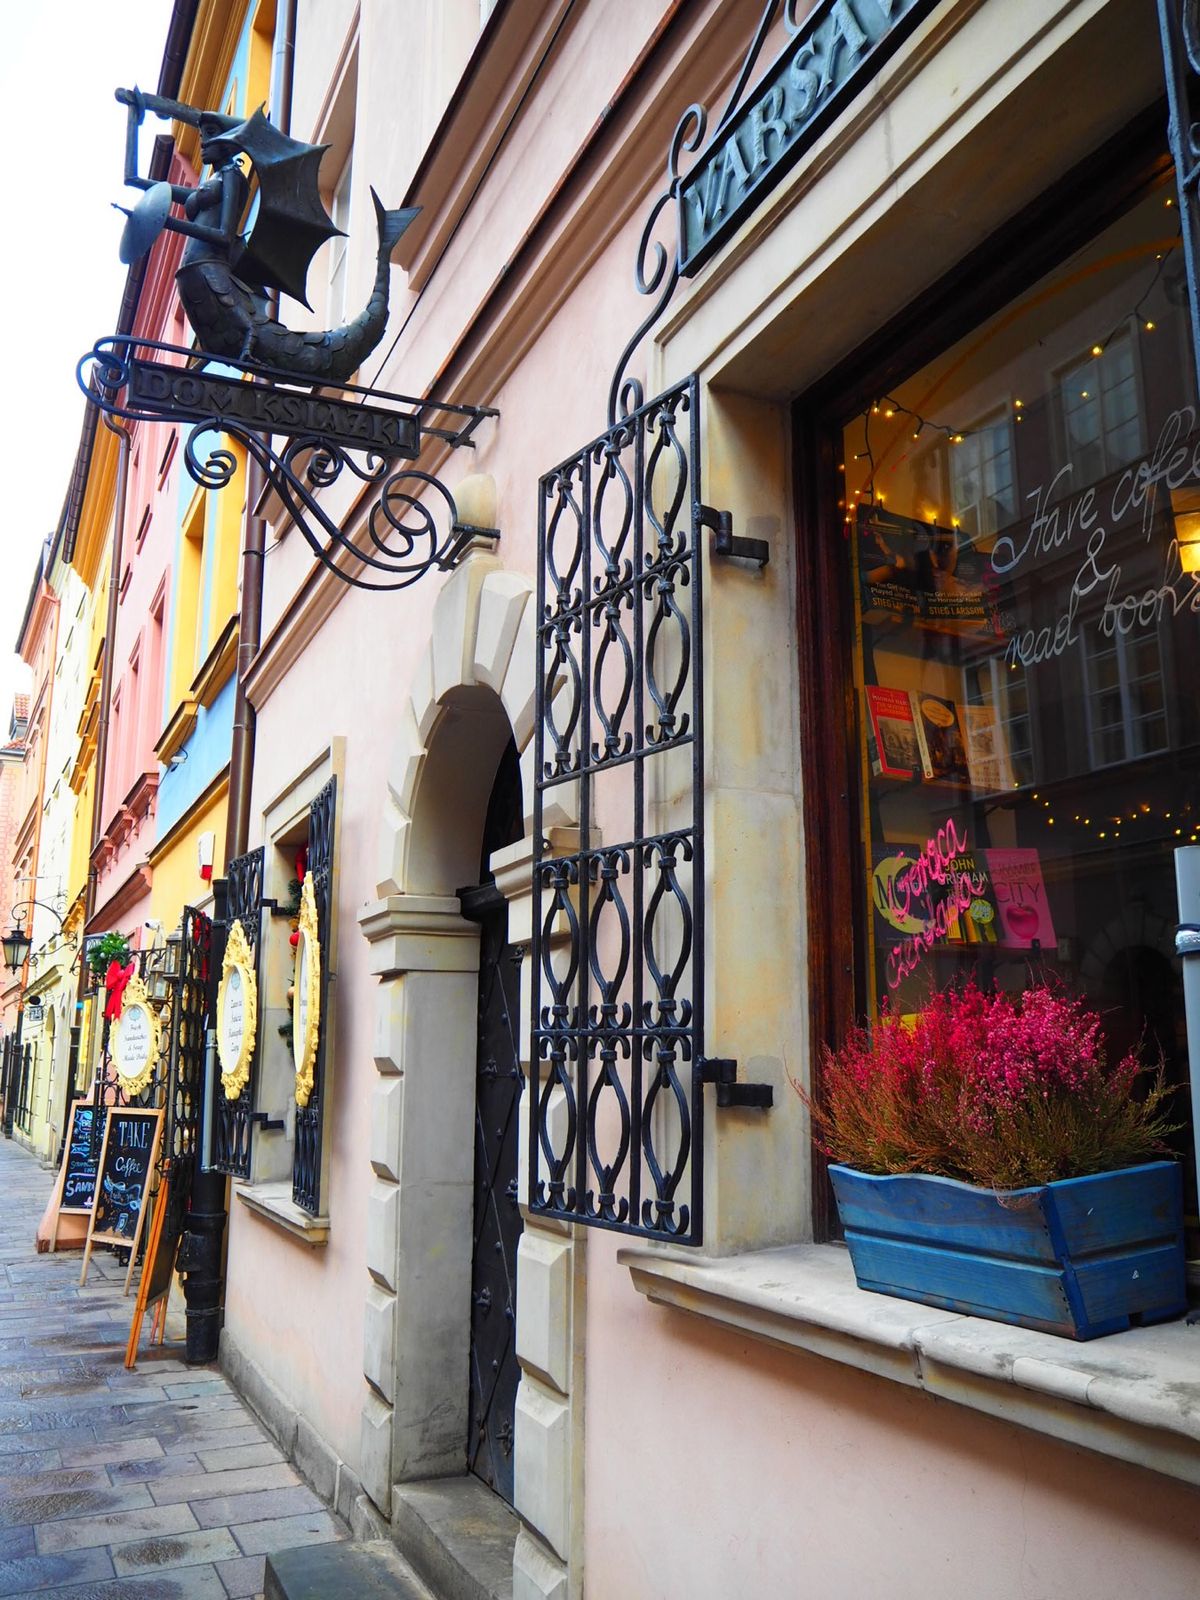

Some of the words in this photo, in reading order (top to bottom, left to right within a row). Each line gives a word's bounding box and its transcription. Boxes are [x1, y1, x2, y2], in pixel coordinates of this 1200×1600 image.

[685, 0, 894, 232] VARSA
[138, 369, 242, 414] DOM
[991, 463, 1099, 574] Have
[1073, 527, 1117, 597] &
[929, 606, 950, 615] STIEG
[952, 606, 984, 616] LARSSON
[1004, 584, 1079, 667] read
[945, 858, 976, 871] JOHN
[993, 882, 1041, 903] CITY
[119, 1121, 151, 1149] TAKE
